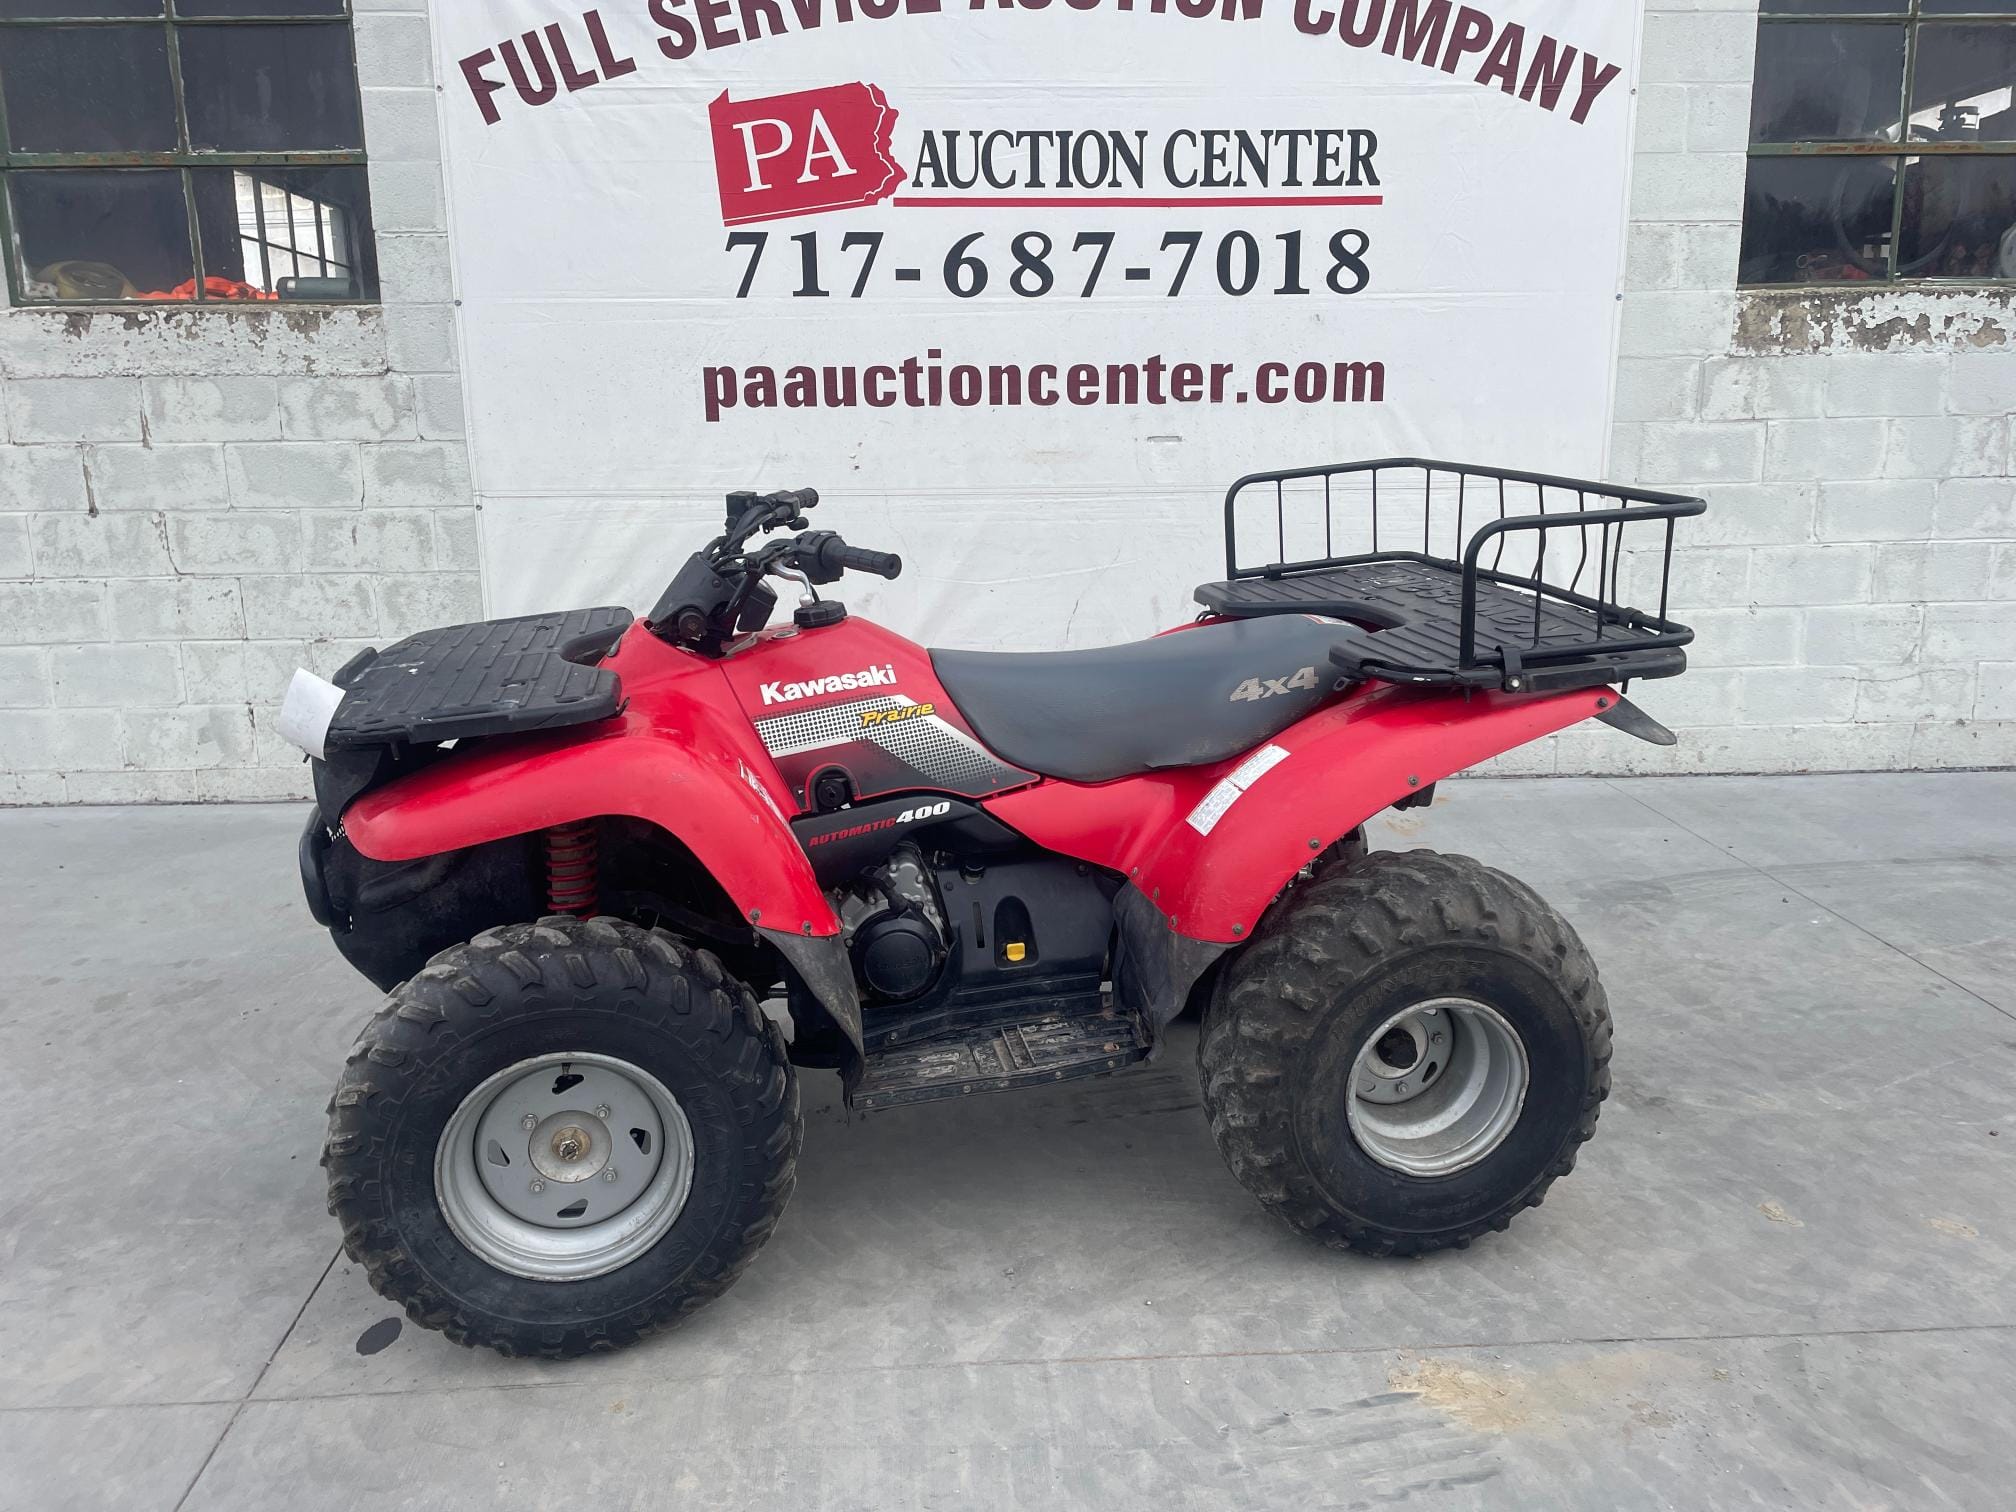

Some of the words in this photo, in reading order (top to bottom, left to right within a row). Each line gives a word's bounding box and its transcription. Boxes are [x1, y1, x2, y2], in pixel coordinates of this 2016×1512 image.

[459, 9, 637, 125] FULL
[732, 108, 858, 193] PA
[911, 129, 1148, 189] AUCTION
[1163, 128, 1380, 188] CENTER
[724, 228, 1370, 298] 717-687-7018
[702, 348, 1385, 422] paauctioncenter.com
[760, 664, 897, 705] Kawasaki
[1229, 666, 1319, 702] 4x4
[860, 702, 934, 729] Prairie
[807, 817, 897, 847] AUTOMATIC
[895, 801, 950, 825] 400
